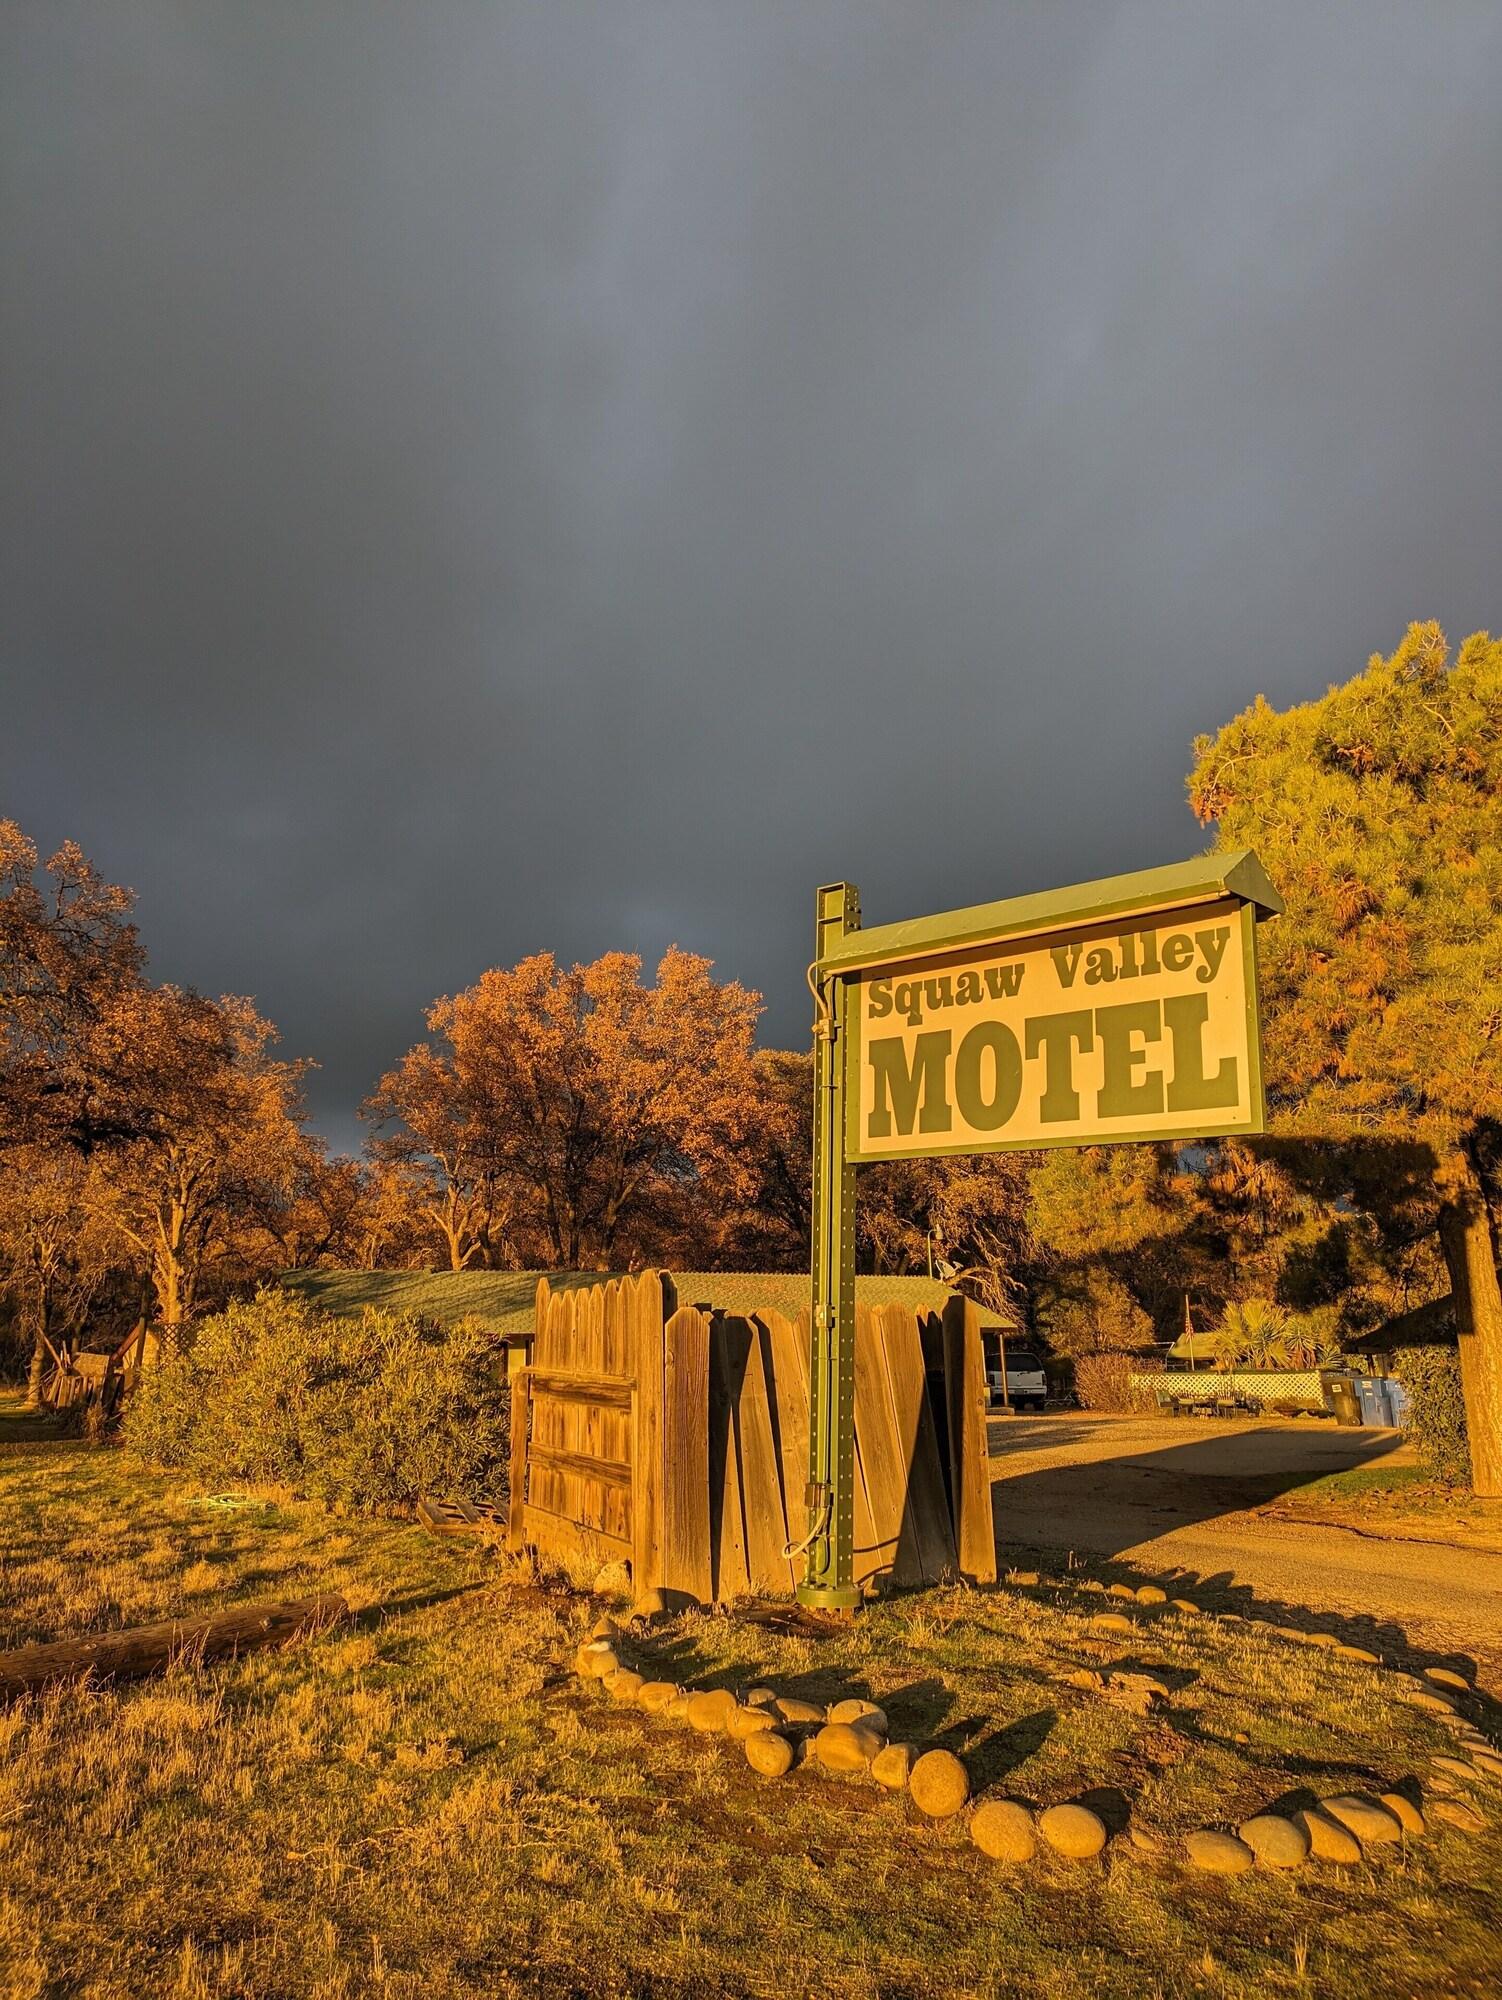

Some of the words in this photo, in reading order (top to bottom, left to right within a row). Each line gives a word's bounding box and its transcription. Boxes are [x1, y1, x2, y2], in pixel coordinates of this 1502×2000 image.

[868, 963, 1025, 1026] Squaw
[1050, 926, 1231, 988] Valley
[868, 992, 1239, 1138] MOTEL
